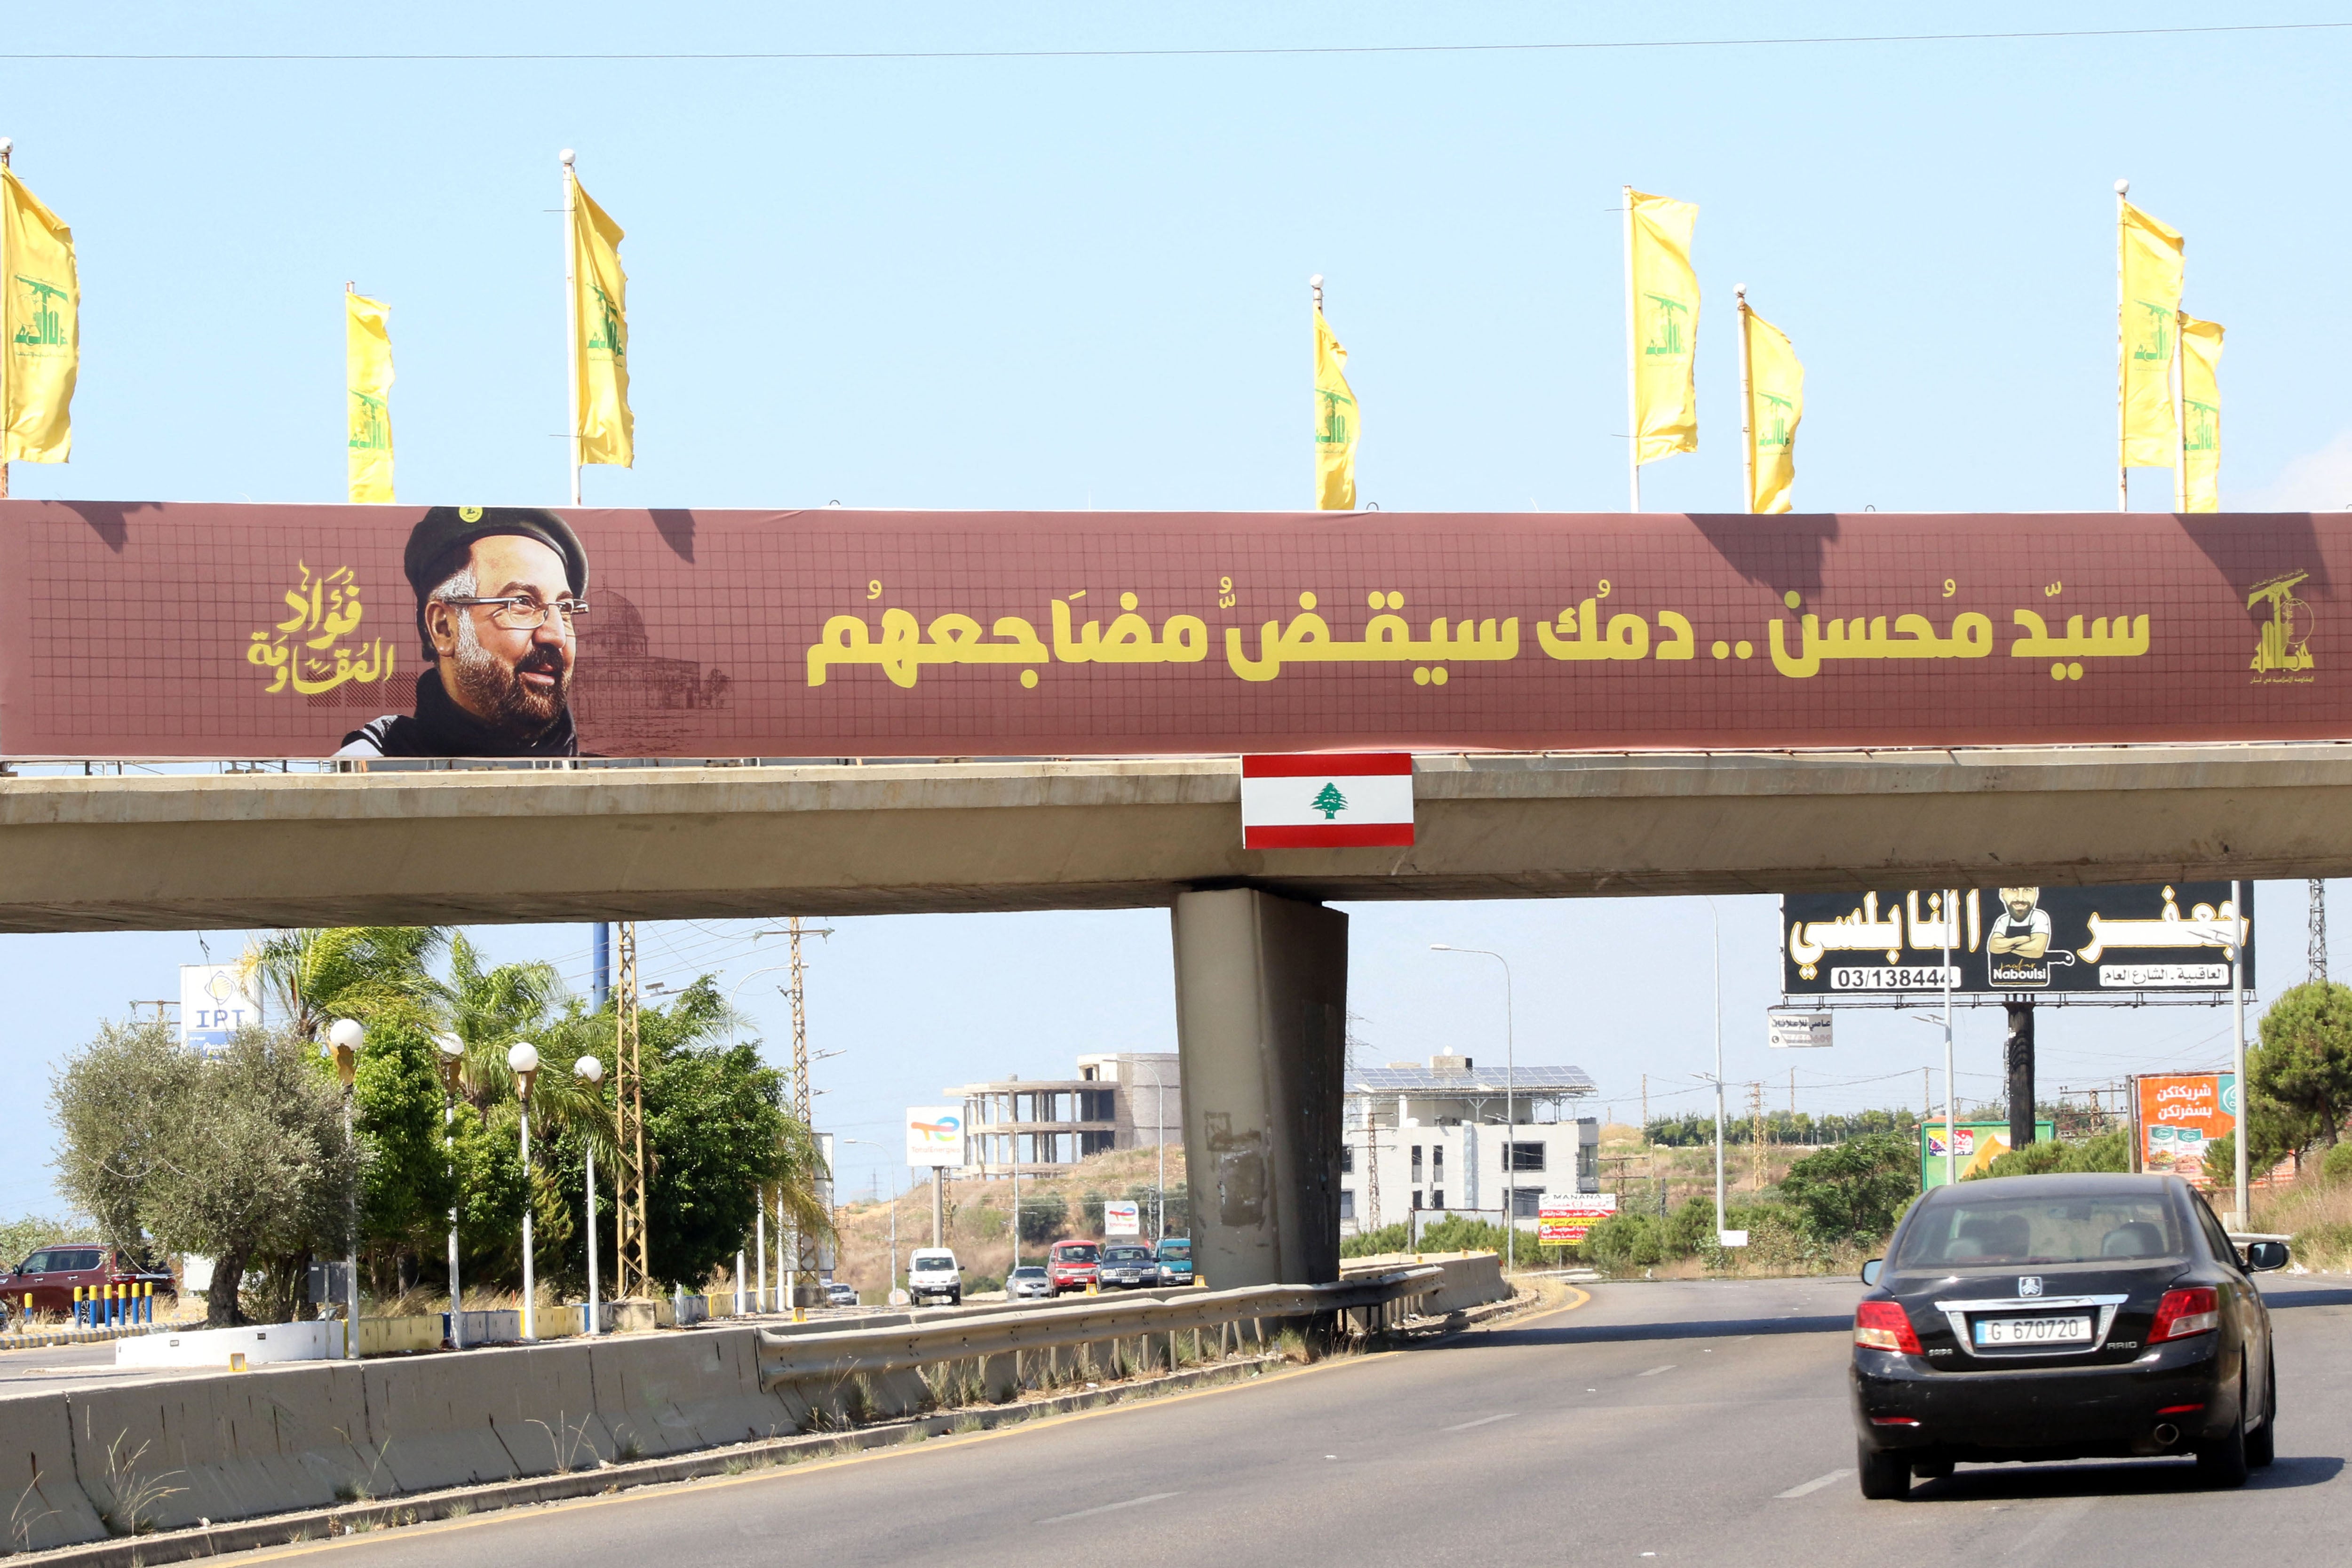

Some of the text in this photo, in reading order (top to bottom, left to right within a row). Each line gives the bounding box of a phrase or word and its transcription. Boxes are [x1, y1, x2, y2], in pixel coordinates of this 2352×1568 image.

[1789, 888, 1981, 980] النابلسي
[1993, 968, 2046, 979] Naboulsi
[2104, 968, 2130, 984] العام
[2132, 967, 2168, 985] الشارع
[2177, 967, 2225, 983] العاقبية
[196, 1009, 245, 1028] IPT
[2156, 1083, 2211, 1102] شريكتكن
[1991, 1319, 2078, 1340] G 670720
